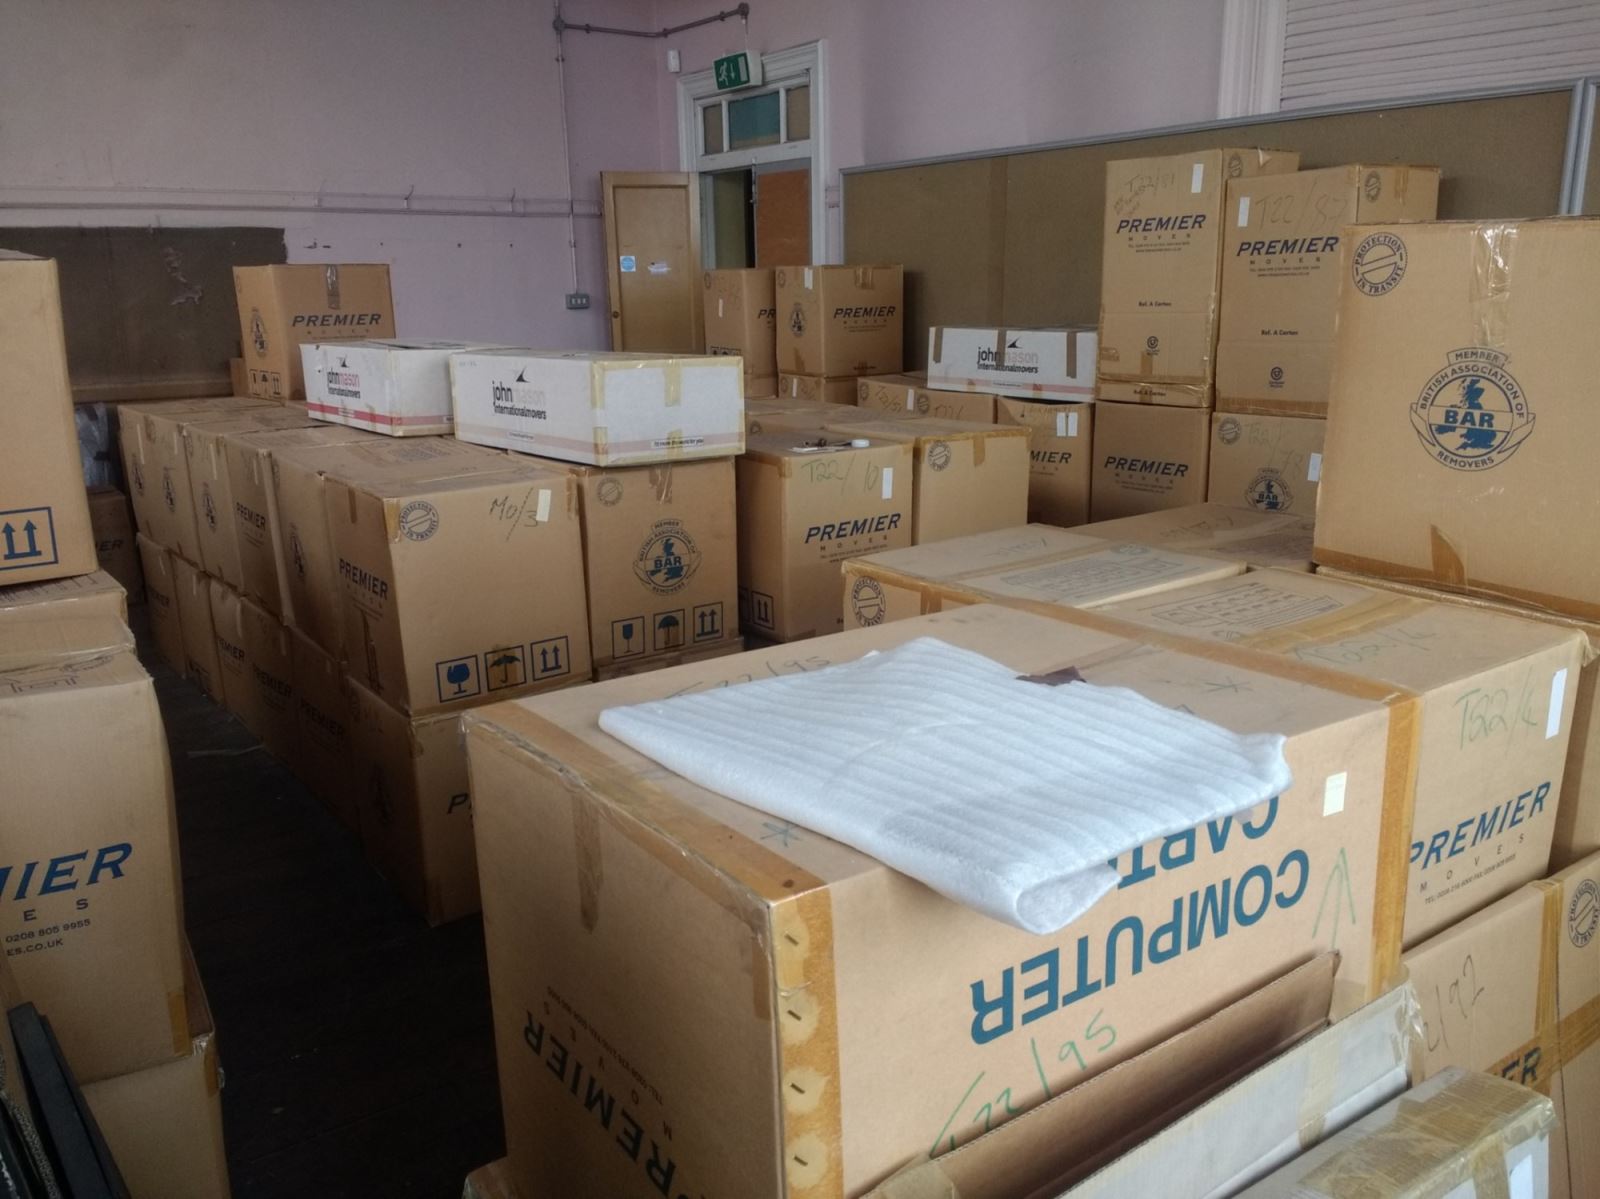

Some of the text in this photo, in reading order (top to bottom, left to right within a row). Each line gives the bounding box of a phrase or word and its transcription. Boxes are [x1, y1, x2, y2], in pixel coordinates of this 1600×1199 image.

[1116, 213, 1207, 234] PREMIER
[1236, 236, 1339, 257] PREMIER
[1356, 235, 1402, 266] PROTECTION
[1368, 266, 1404, 294] TRANSIT
[292, 313, 382, 327] PREMIER
[834, 305, 896, 319] PREMIER
[1455, 350, 1499, 363] MEMBER
[1420, 364, 1525, 419] BRITISH ASSOCIATION OF
[1444, 409, 1494, 428] BAR
[1104, 455, 1189, 478] PREMIER
[1437, 450, 1495, 468] REMOVERS
[804, 513, 902, 544] PREMIER
[654, 556, 682, 569] BAR
[339, 558, 389, 600] PREMIER
[1409, 781, 1552, 871] PREMIER
[0, 842, 132, 901] IER
[5, 918, 91, 943] 0208 805 9955
[970, 849, 1311, 1045] COMPUTER
[523, 1009, 692, 1199] REMIER
